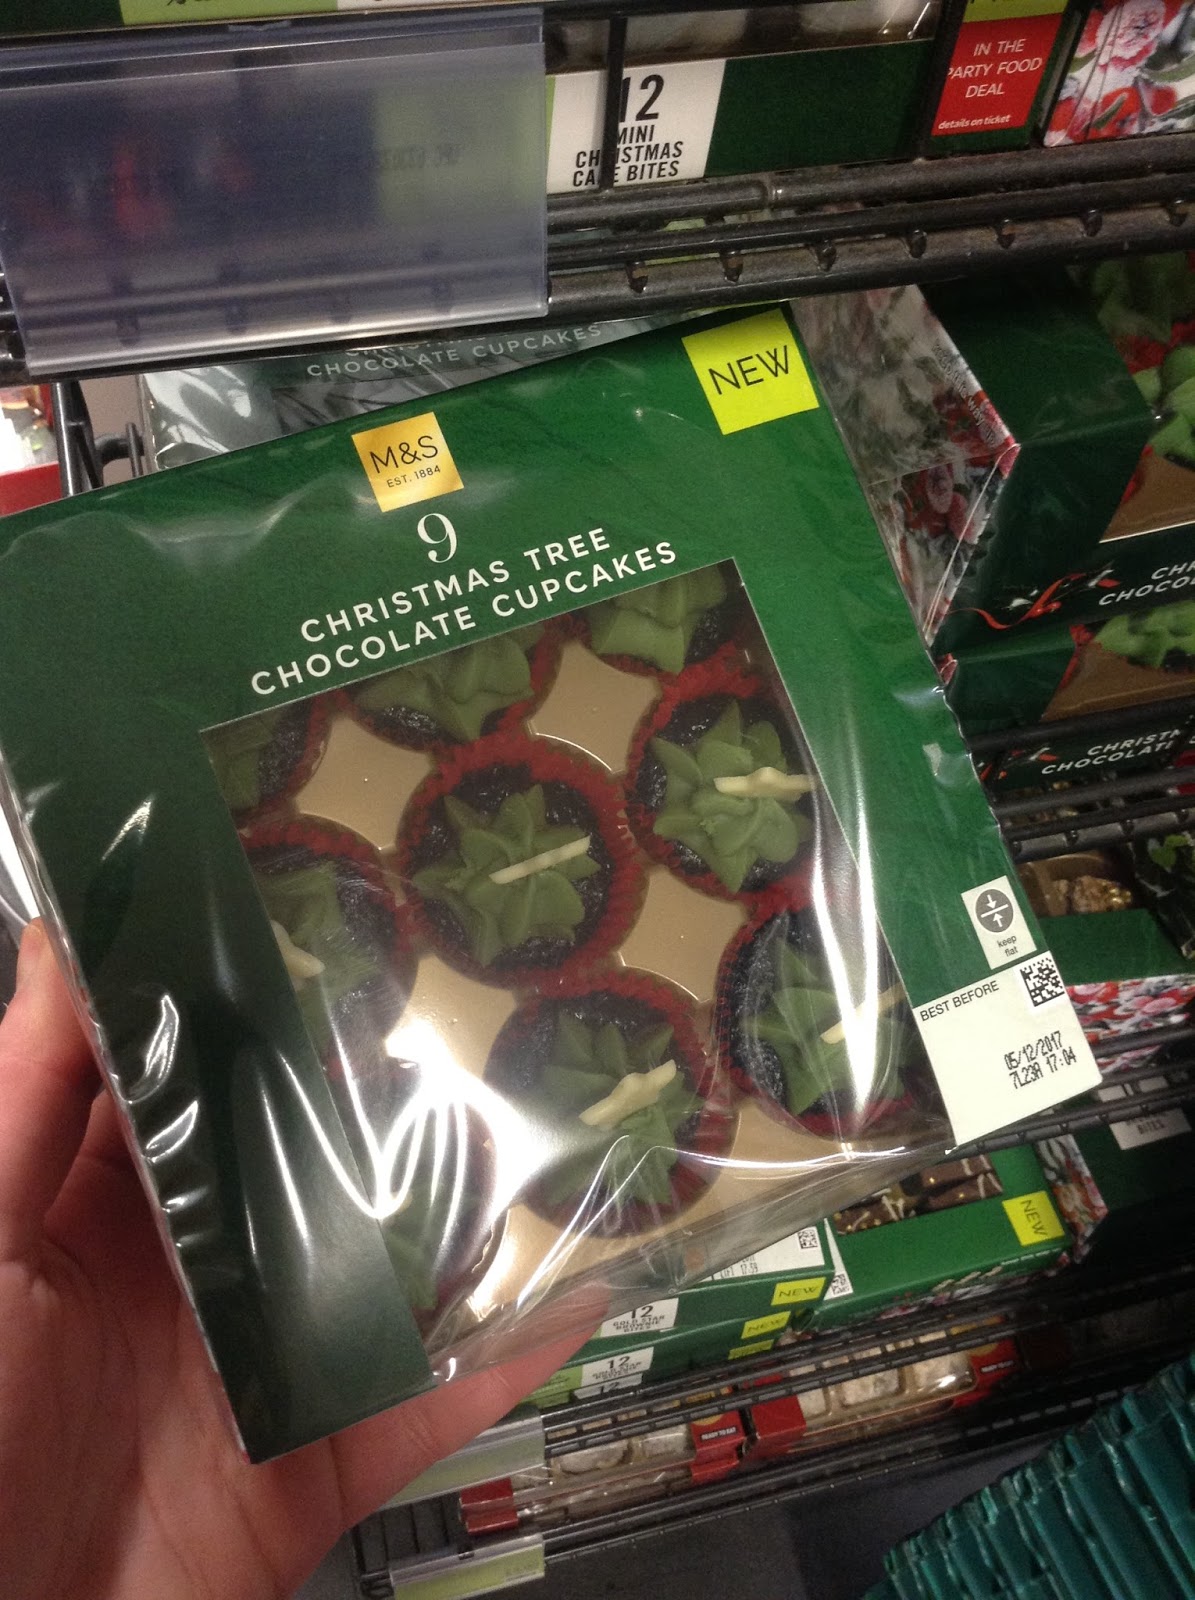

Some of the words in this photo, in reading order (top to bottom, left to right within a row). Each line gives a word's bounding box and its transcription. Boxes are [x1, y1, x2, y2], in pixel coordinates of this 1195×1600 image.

[973, 42, 992, 56] IN
[997, 38, 1026, 54] THE
[996, 57, 1042, 75] FOOD
[619, 74, 665, 123] 12
[965, 82, 1005, 98] DEAL
[938, 118, 970, 130] details
[970, 117, 983, 127] on
[983, 114, 1012, 125] ticket
[575, 140, 684, 169] CHISTMAS
[572, 165, 621, 187] CAE
[626, 160, 680, 182] BITES
[306, 349, 460, 377] CHOCOLATE
[472, 324, 602, 359] CUPCAKES
[708, 344, 790, 396] NEW
[369, 435, 439, 475] M&S
[386, 473, 413, 489] EST.
[413, 464, 441, 480] 1884
[416, 512, 459, 564] 9
[300, 560, 510, 643] CHRISTMAS
[523, 527, 611, 572] TREE
[250, 606, 477, 696] CHOCOLATE
[491, 541, 677, 618] CUPCAKES
[996, 935, 1017, 948] keep
[1004, 945, 1018, 957] flat
[920, 1000, 950, 1022] BEST
[952, 980, 1000, 1008] BEFORE
[1003, 1030, 1063, 1070] 05/12/2017
[1046, 1046, 1077, 1073] 17:04
[1020, 1199, 1049, 1236] NEW
[778, 1286, 820, 1298] NEW
[631, 1305, 654, 1318] 12
[608, 1356, 630, 1369] 12
